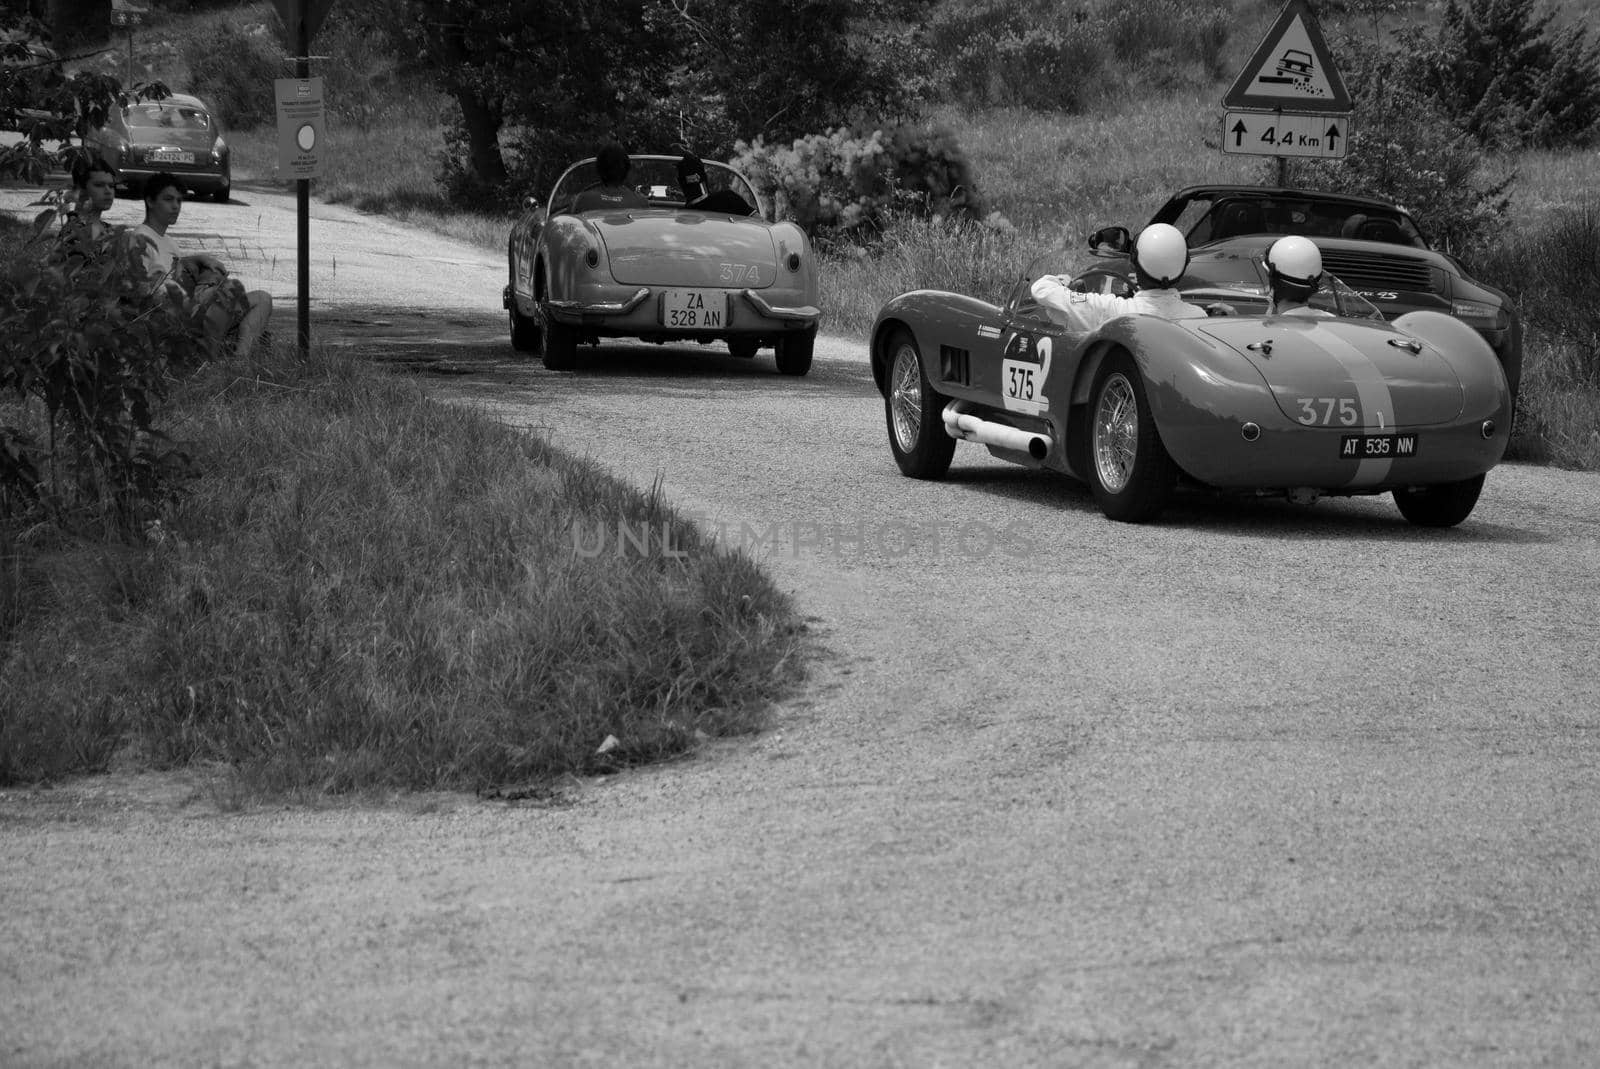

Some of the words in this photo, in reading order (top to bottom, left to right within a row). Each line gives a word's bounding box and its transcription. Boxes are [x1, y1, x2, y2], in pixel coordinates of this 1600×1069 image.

[1260, 126, 1293, 147] 4,4
[1298, 134, 1320, 147] Km
[720, 262, 760, 283] 374
[687, 293, 704, 309] ZA
[670, 310, 697, 326] 328
[703, 310, 720, 327] AN
[1009, 366, 1034, 400] 375
[1296, 398, 1358, 426] 375
[1343, 438, 1359, 455] AT
[1365, 438, 1391, 454] 535
[1396, 437, 1414, 453] NN
